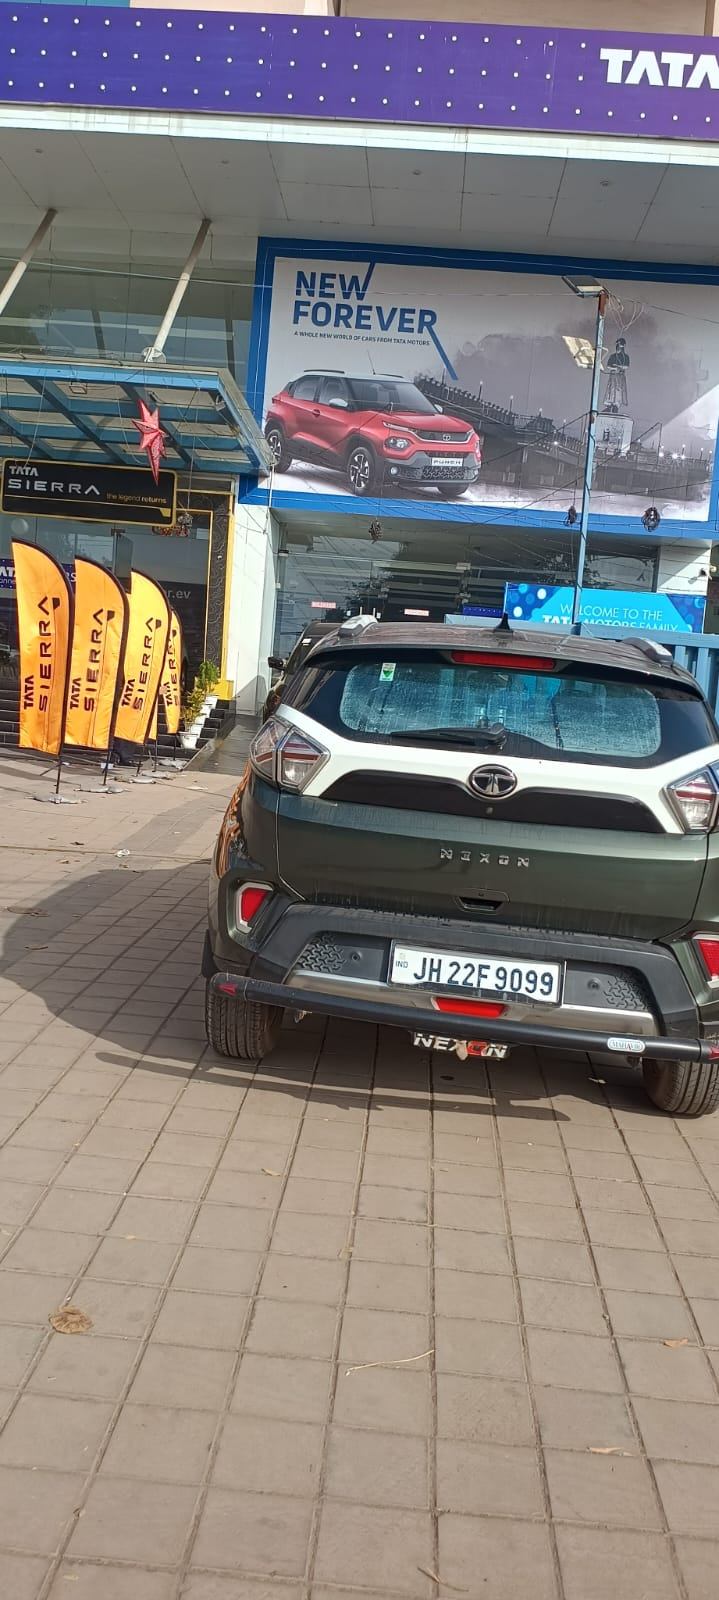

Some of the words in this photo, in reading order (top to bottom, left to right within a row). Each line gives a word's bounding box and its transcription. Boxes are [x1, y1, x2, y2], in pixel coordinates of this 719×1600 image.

[599, 47, 719, 90] TATA
[295, 264, 374, 301] NEW
[292, 300, 439, 335] FOREVER
[8, 478, 100, 496] SIERRA
[9, 465, 39, 477] TATA
[106, 492, 117, 501] the
[118, 493, 141, 503] legend
[141, 496, 168, 505] returns
[622, 608, 639, 620] TO
[642, 609, 663, 621] THE
[37, 595, 53, 713] SIERRA
[84, 607, 105, 713] SIERRA
[131, 617, 154, 711] SIERRA
[24, 674, 34, 710] TATA
[69, 676, 82, 710] TATA
[121, 678, 136, 707] TATA
[440, 848, 530, 868] NEXON
[395, 960, 409, 969] IND
[413, 957, 442, 984] JH
[494, 966, 554, 997] 9099
